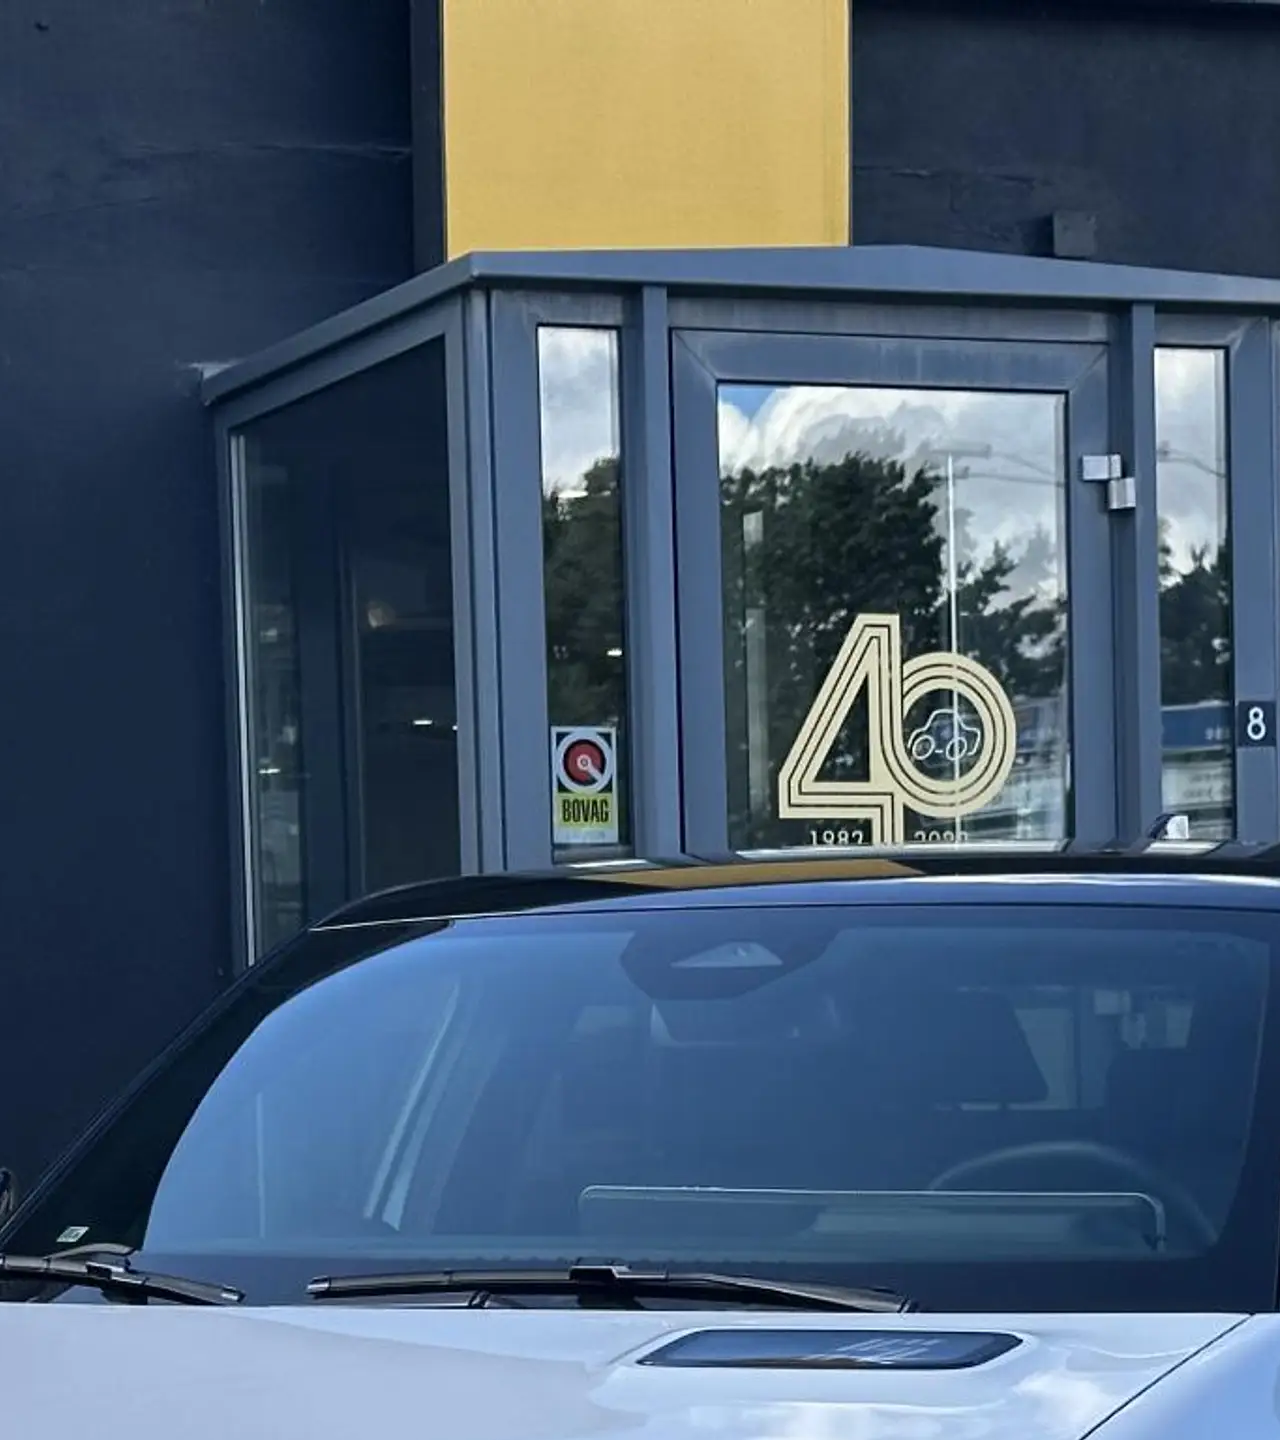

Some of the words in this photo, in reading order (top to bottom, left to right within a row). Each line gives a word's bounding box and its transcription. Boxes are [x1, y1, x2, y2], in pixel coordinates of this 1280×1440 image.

[778, 613, 1017, 845] 40
[1246, 706, 1266, 740] 8
[561, 798, 610, 824] BOVAG
